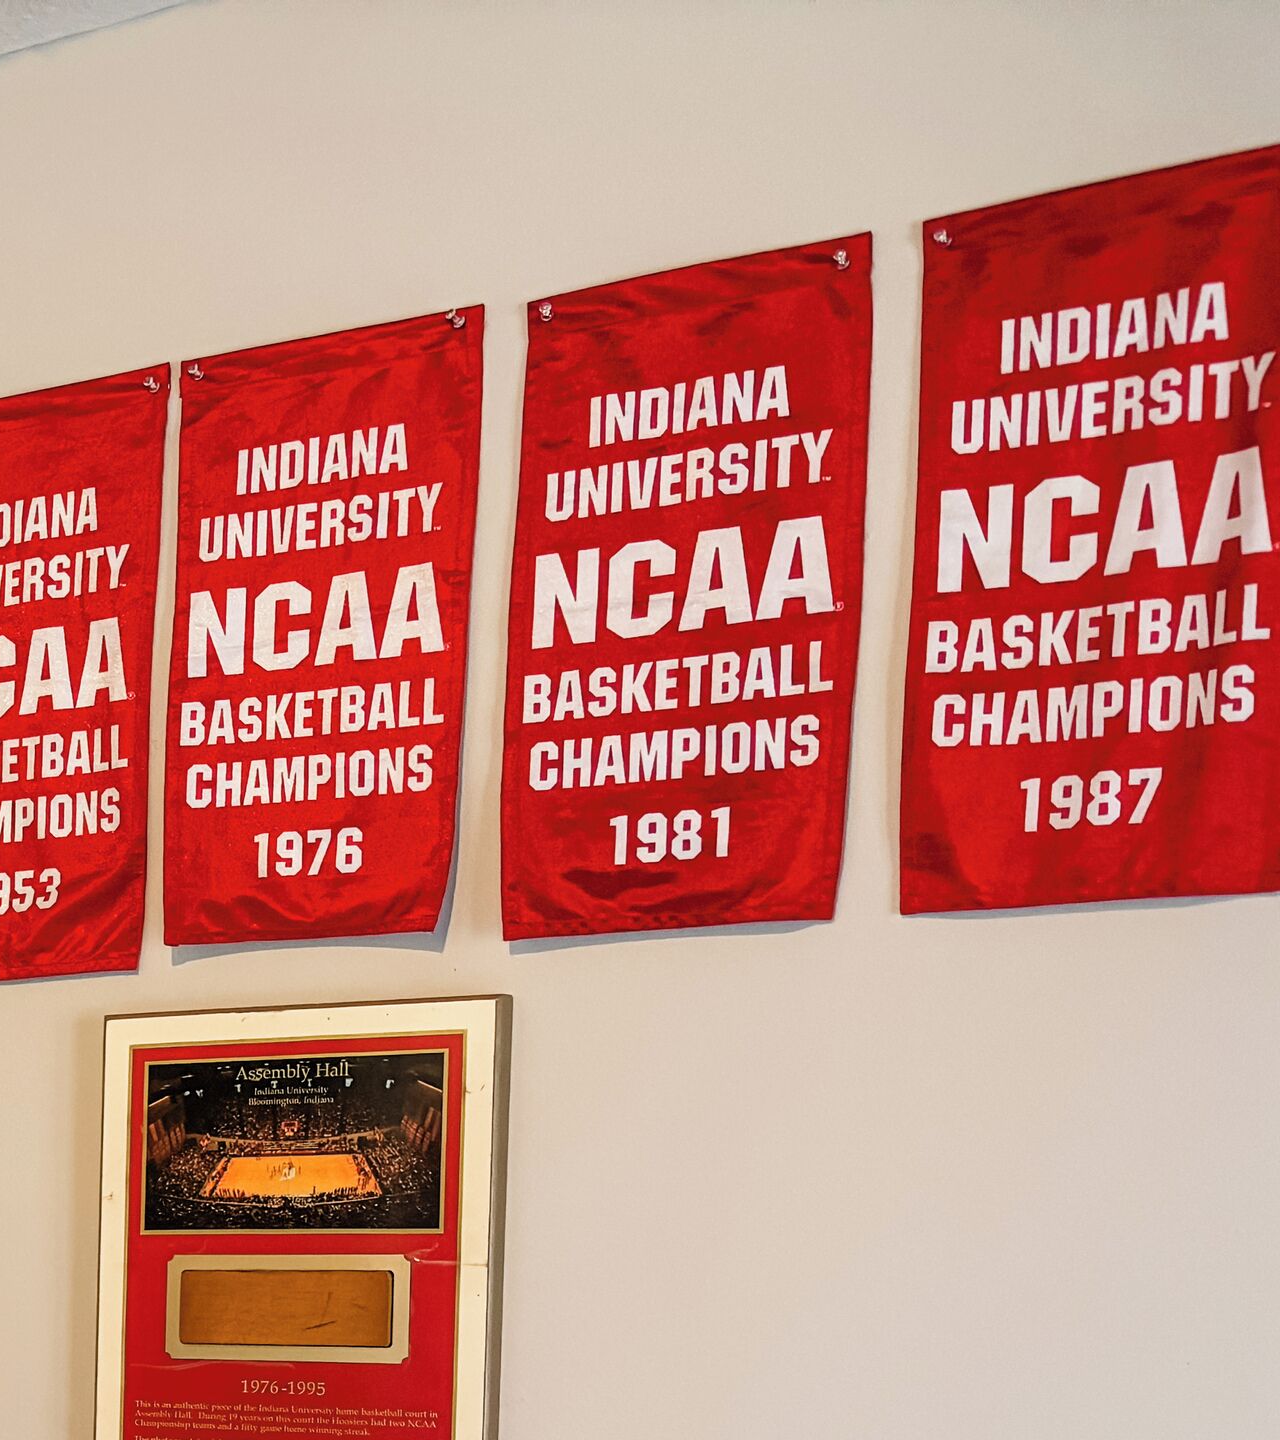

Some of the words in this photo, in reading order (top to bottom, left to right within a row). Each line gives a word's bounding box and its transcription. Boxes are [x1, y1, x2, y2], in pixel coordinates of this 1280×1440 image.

[1000, 281, 1229, 374] INDIANA
[588, 366, 790, 449] INDIANA
[951, 352, 1276, 454] UNIVERSITY
[236, 423, 409, 496] INDIANA
[544, 428, 833, 522] UNIVERSITY
[198, 482, 443, 562] UNIVERSITY
[937, 446, 1272, 593] NCAA
[531, 515, 835, 649] NCAA
[187, 562, 446, 678] NCAA
[924, 584, 1271, 674] BASKETBALL
[180, 678, 444, 746] BASKETBALL
[522, 641, 833, 724] BASKETBALL
[931, 664, 1255, 748] CHAMPIONS
[185, 744, 434, 809] CHAMPIONS
[528, 714, 820, 791] CHAMPIONS
[609, 806, 731, 866] 1981
[1019, 767, 1162, 832] 1987
[253, 826, 363, 878] 1976
[236, 1064, 310, 1082] Assembly
[315, 1061, 350, 1077] Hall
[287, 1087, 328, 1095] University
[304, 1096, 334, 1104] Indiana
[136, 1410, 170, 1418] Assembly
[198, 1412, 226, 1421] During
[275, 1415, 290, 1424] this
[332, 1417, 368, 1425] Hoosiers
[408, 1420, 436, 1428] NCAA
[173, 1402, 208, 1410] authentic
[259, 1404, 288, 1414] Indiana
[291, 1406, 334, 1415] University
[362, 1408, 402, 1417] basketball
[240, 1379, 326, 1396] 1976-1995
[135, 1420, 190, 1430] Championship
